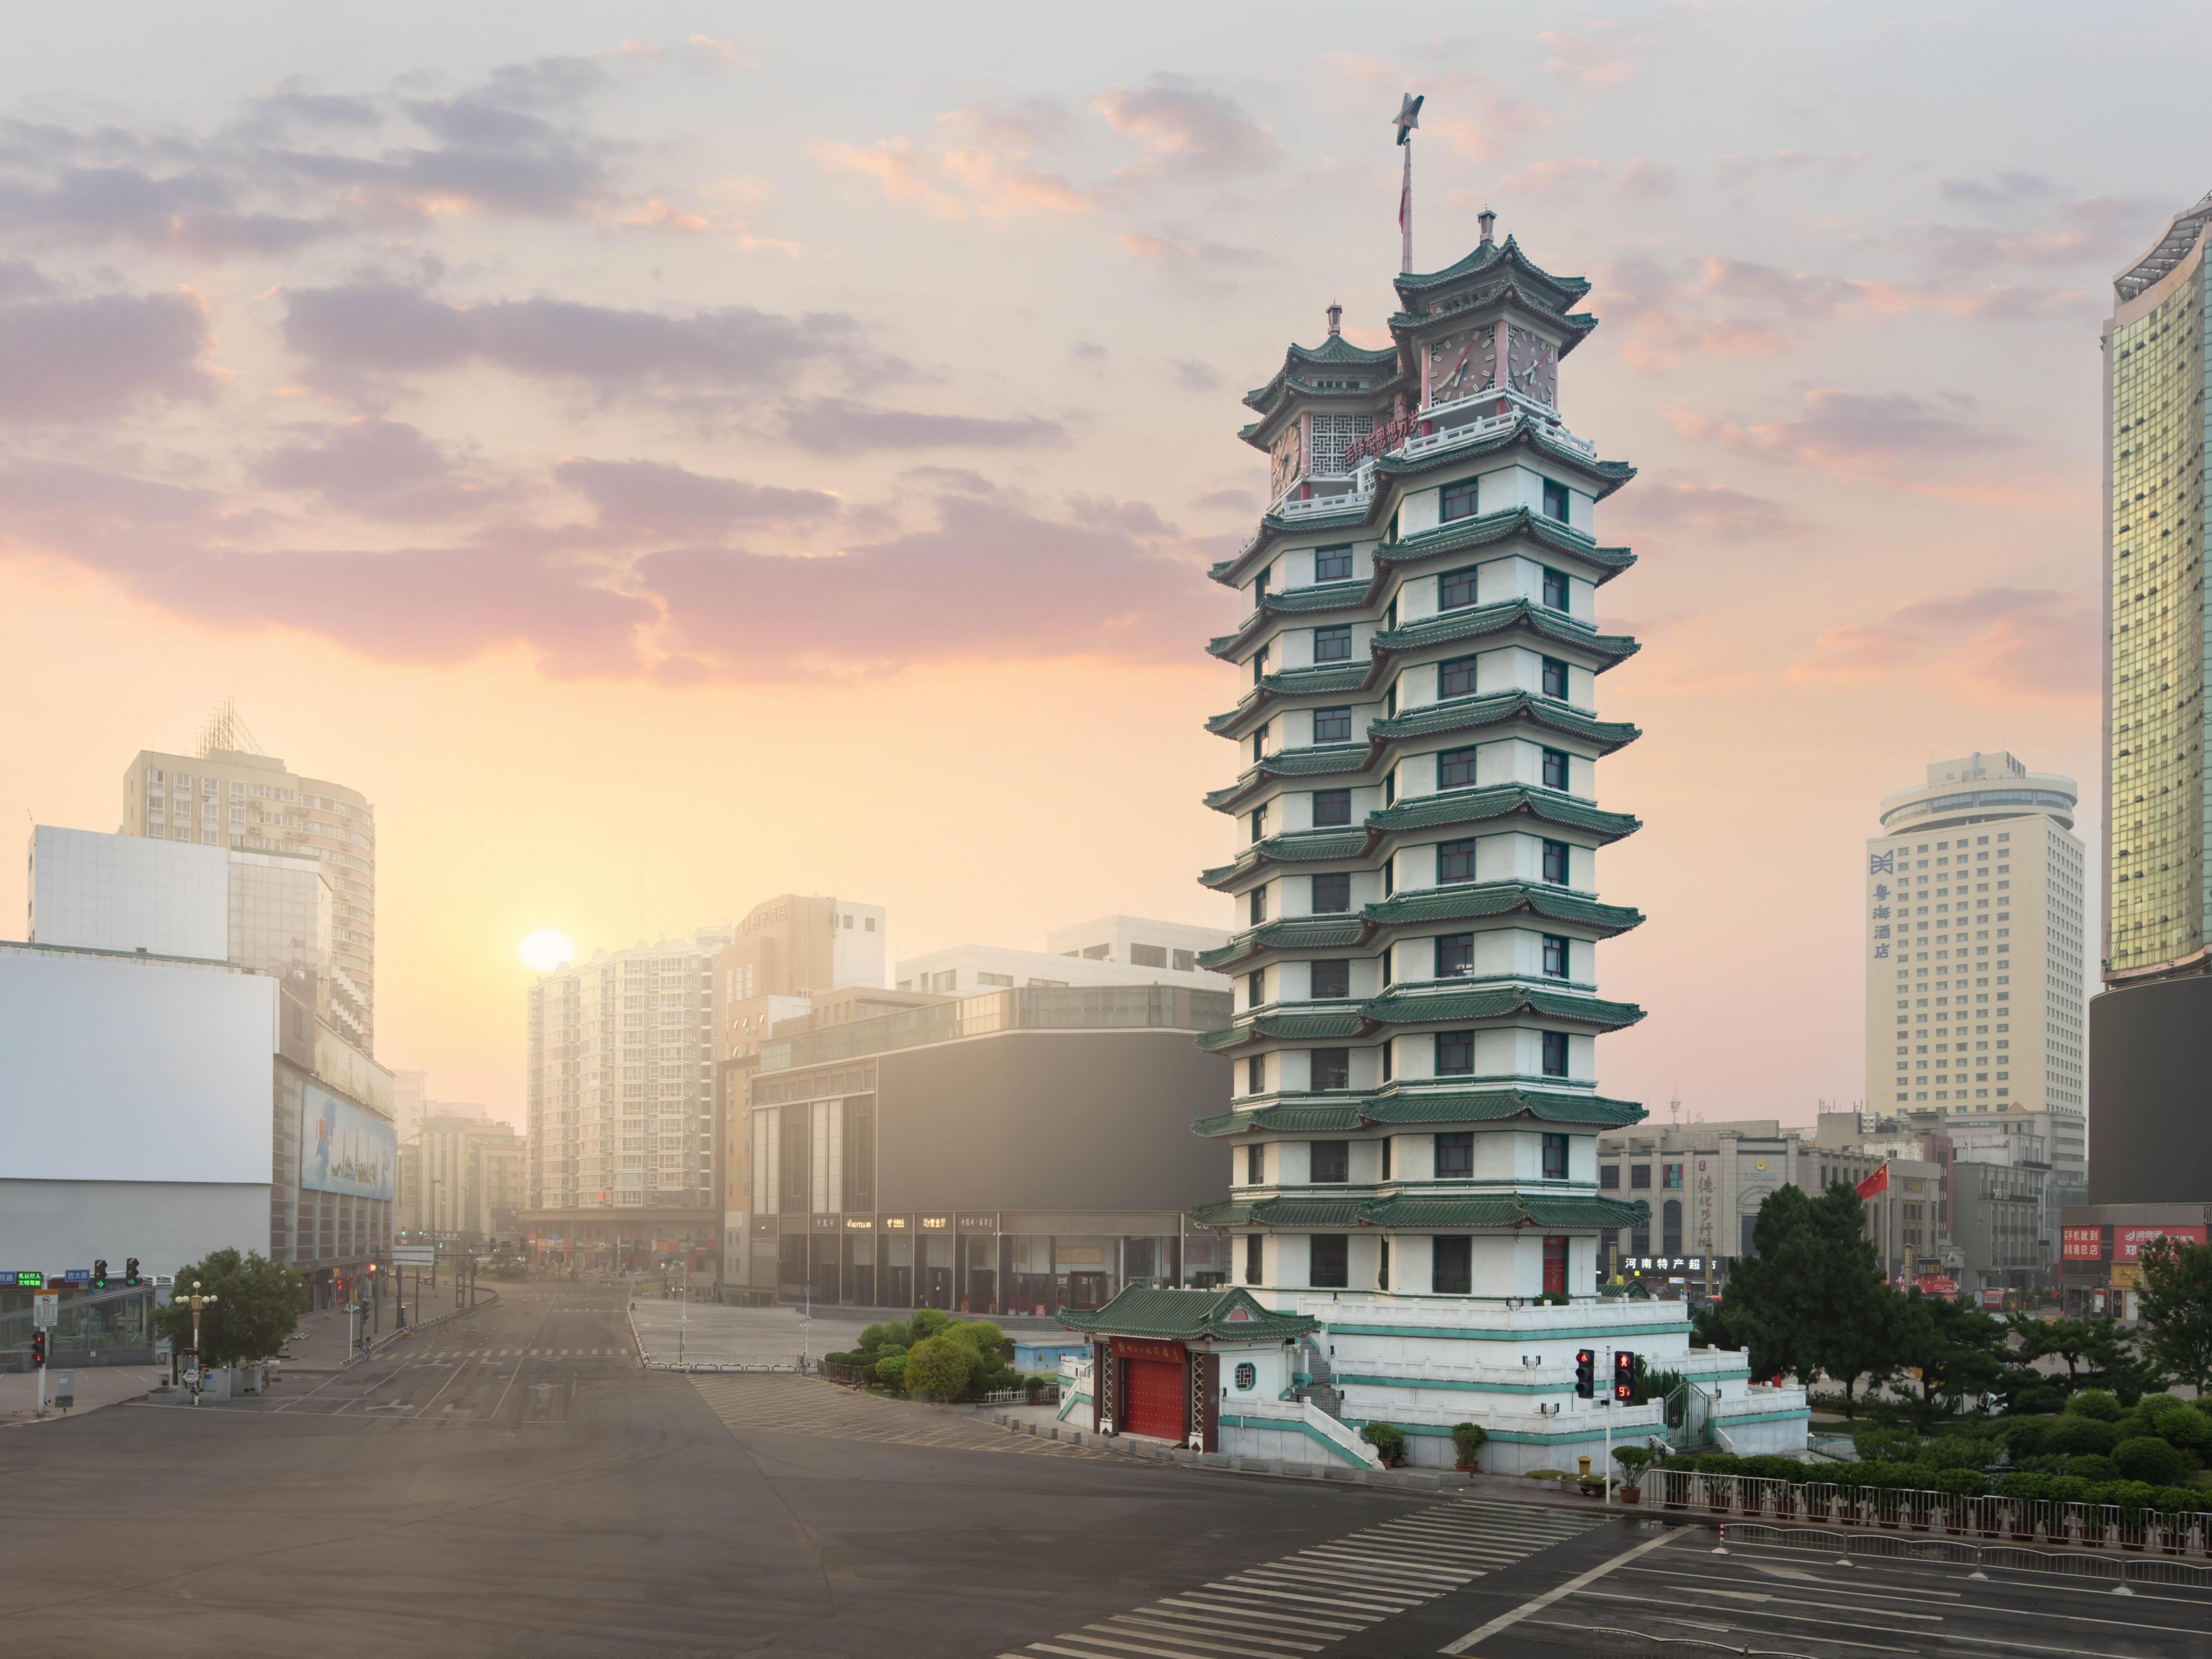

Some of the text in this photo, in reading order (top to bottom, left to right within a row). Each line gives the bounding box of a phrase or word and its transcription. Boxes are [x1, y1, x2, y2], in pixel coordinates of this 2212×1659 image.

[1345, 410, 1418, 465] 毛泽东思想万岁
[1872, 883, 1891, 958] 粤海酒店
[1745, 1172, 1775, 1181] 苏宁易购
[2064, 1230, 2098, 1240] 买手机就到
[2064, 1244, 2098, 1255] 迪信通总店
